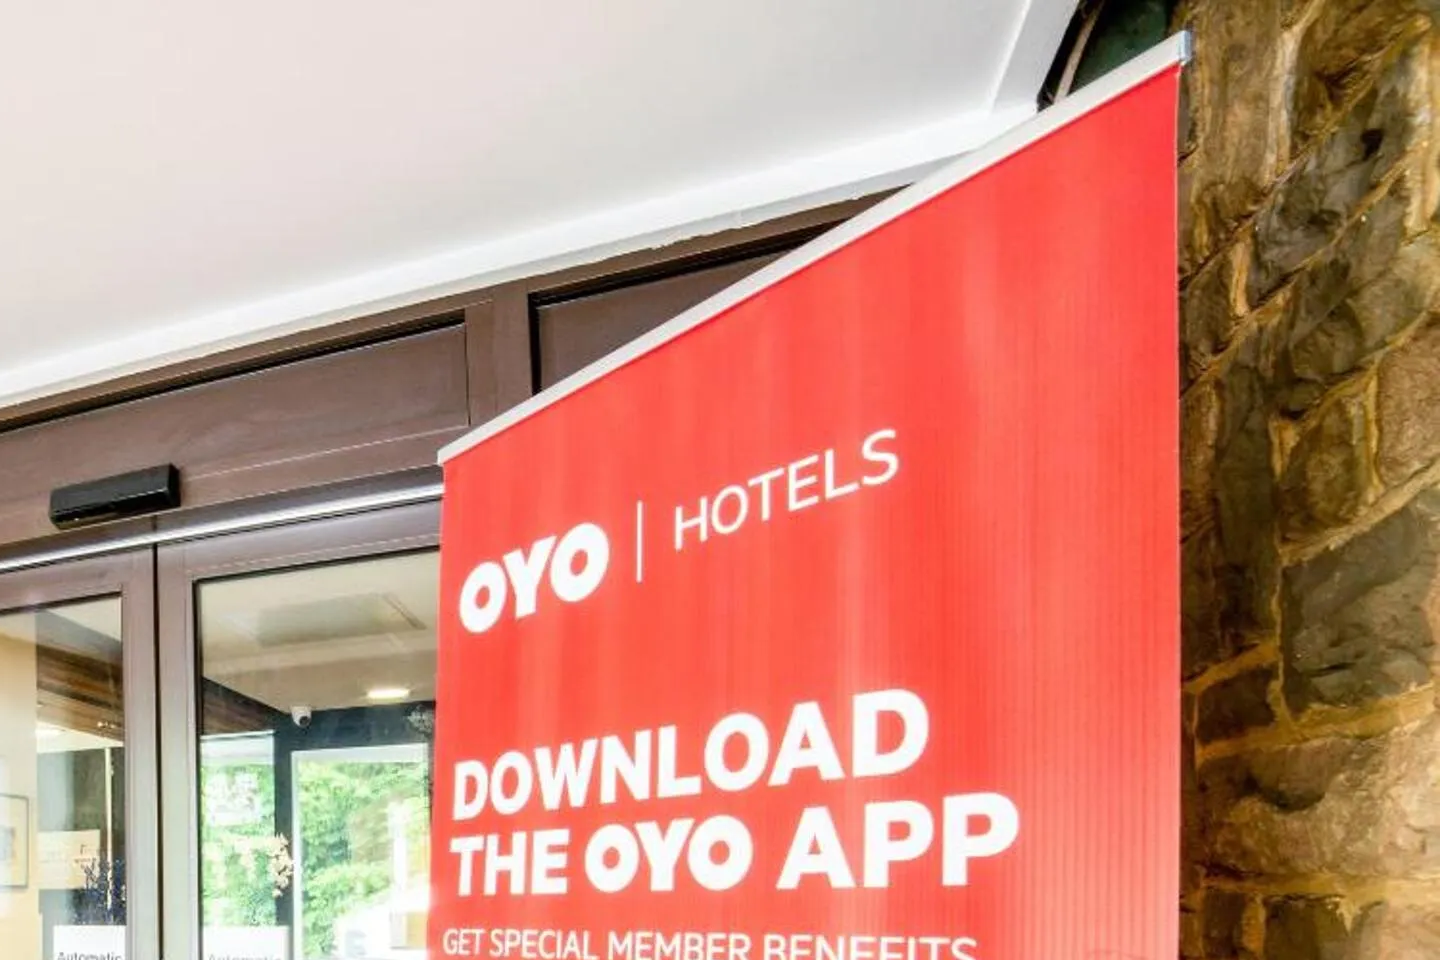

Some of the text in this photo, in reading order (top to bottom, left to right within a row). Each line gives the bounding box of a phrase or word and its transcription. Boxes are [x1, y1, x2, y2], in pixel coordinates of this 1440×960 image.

[459, 429, 900, 634] OYO HOTELS
[452, 689, 929, 821] DOWNLOAD
[449, 793, 1020, 897] THE OYO APP
[442, 928, 485, 957] GET
